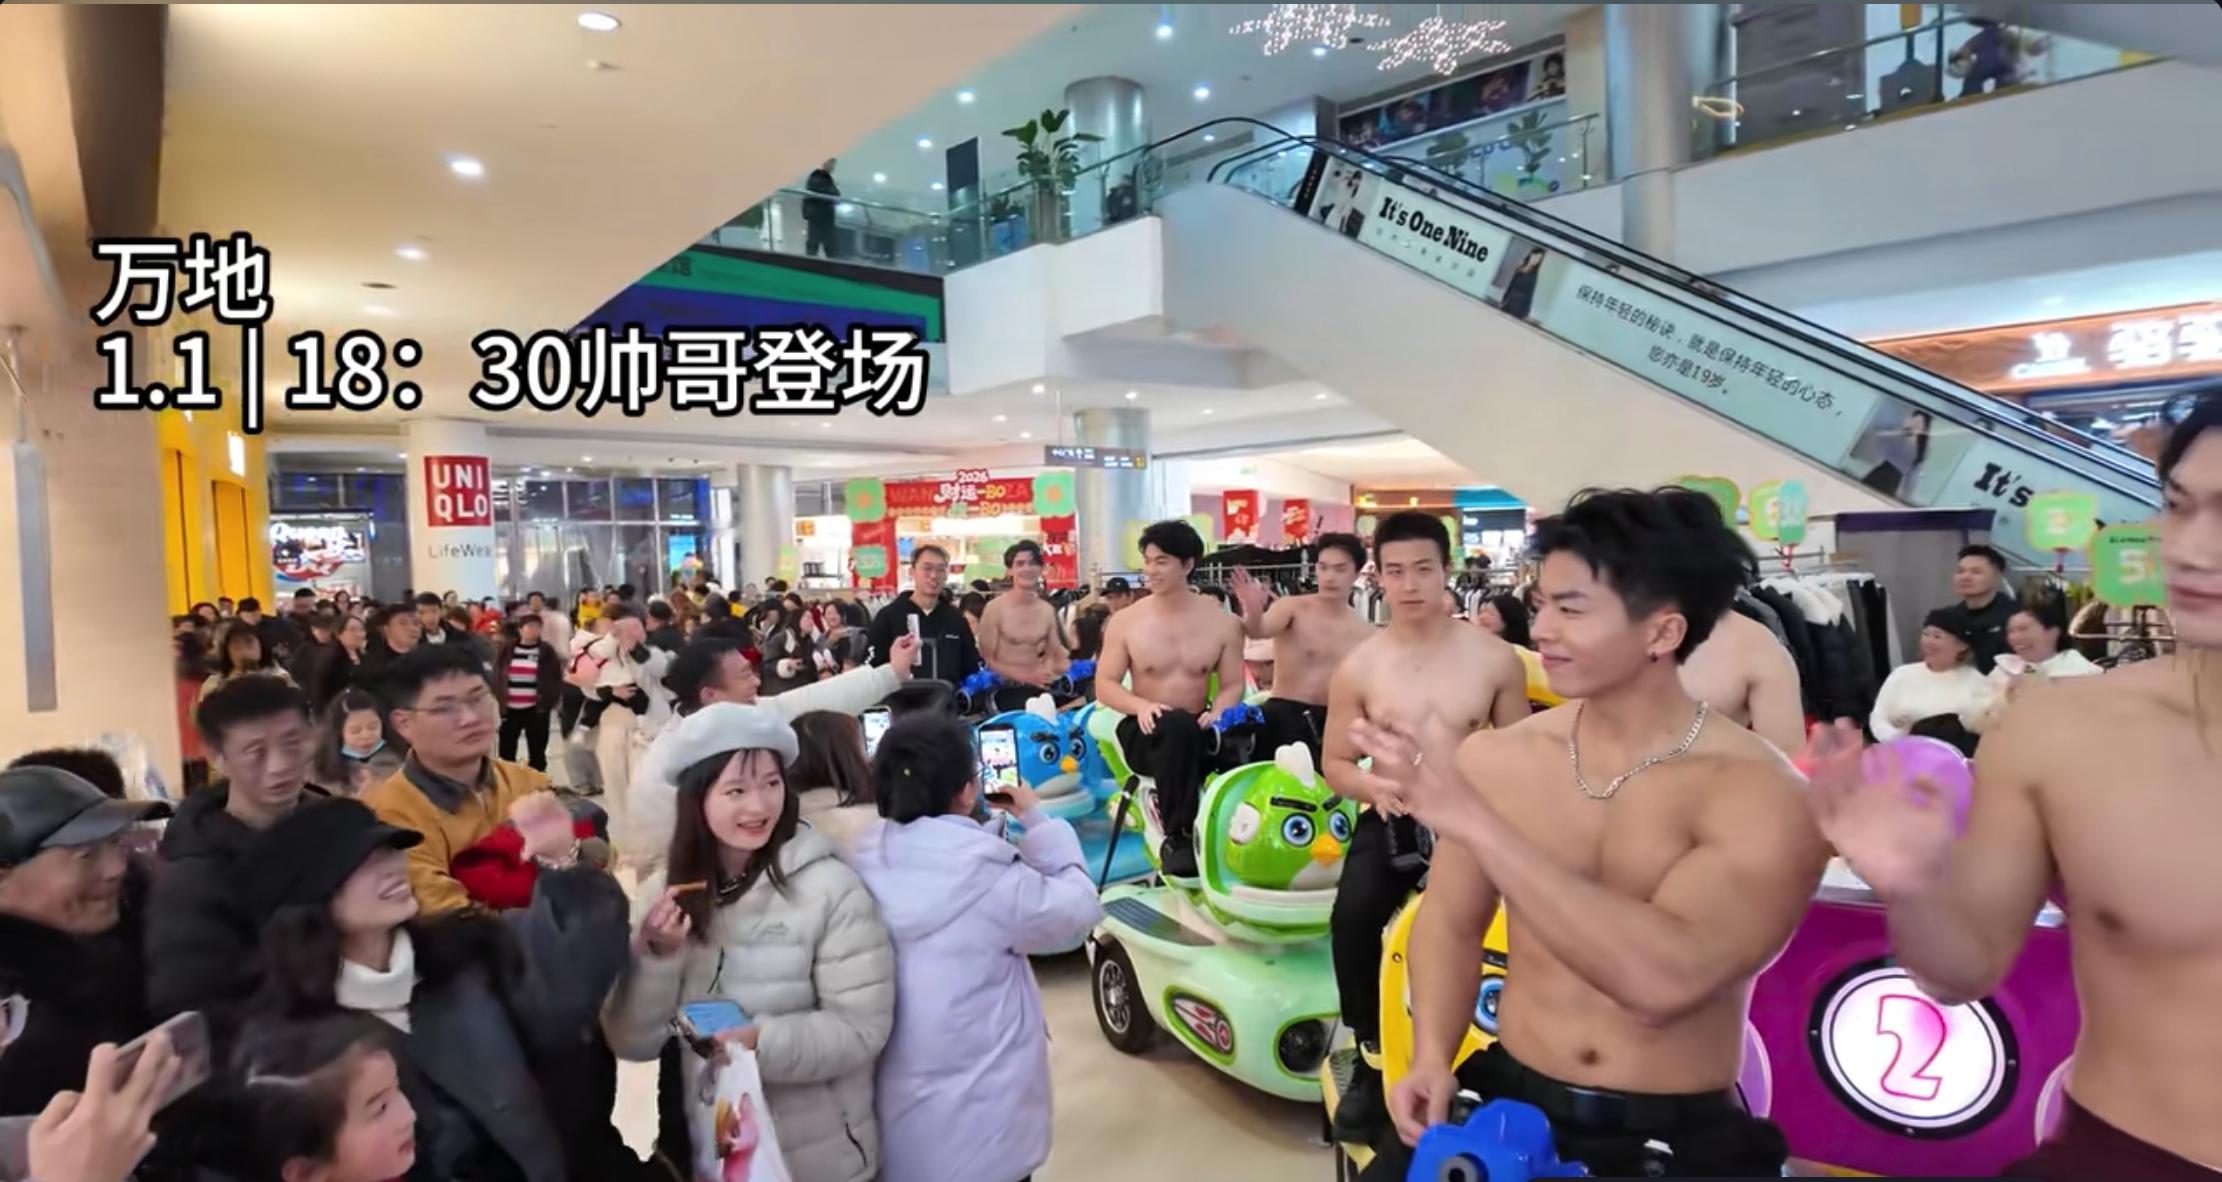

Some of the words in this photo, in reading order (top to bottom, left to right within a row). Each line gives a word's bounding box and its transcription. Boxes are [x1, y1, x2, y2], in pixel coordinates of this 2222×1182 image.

[1378, 196, 1409, 227] It's
[1408, 211, 1445, 243] One
[1443, 225, 1489, 263] Nine
[431, 464, 484, 490] UNI
[958, 471, 988, 483] 2026
[1973, 462, 2035, 508] It's
[434, 493, 488, 522] QLO
[1876, 993, 1948, 1101] 2
